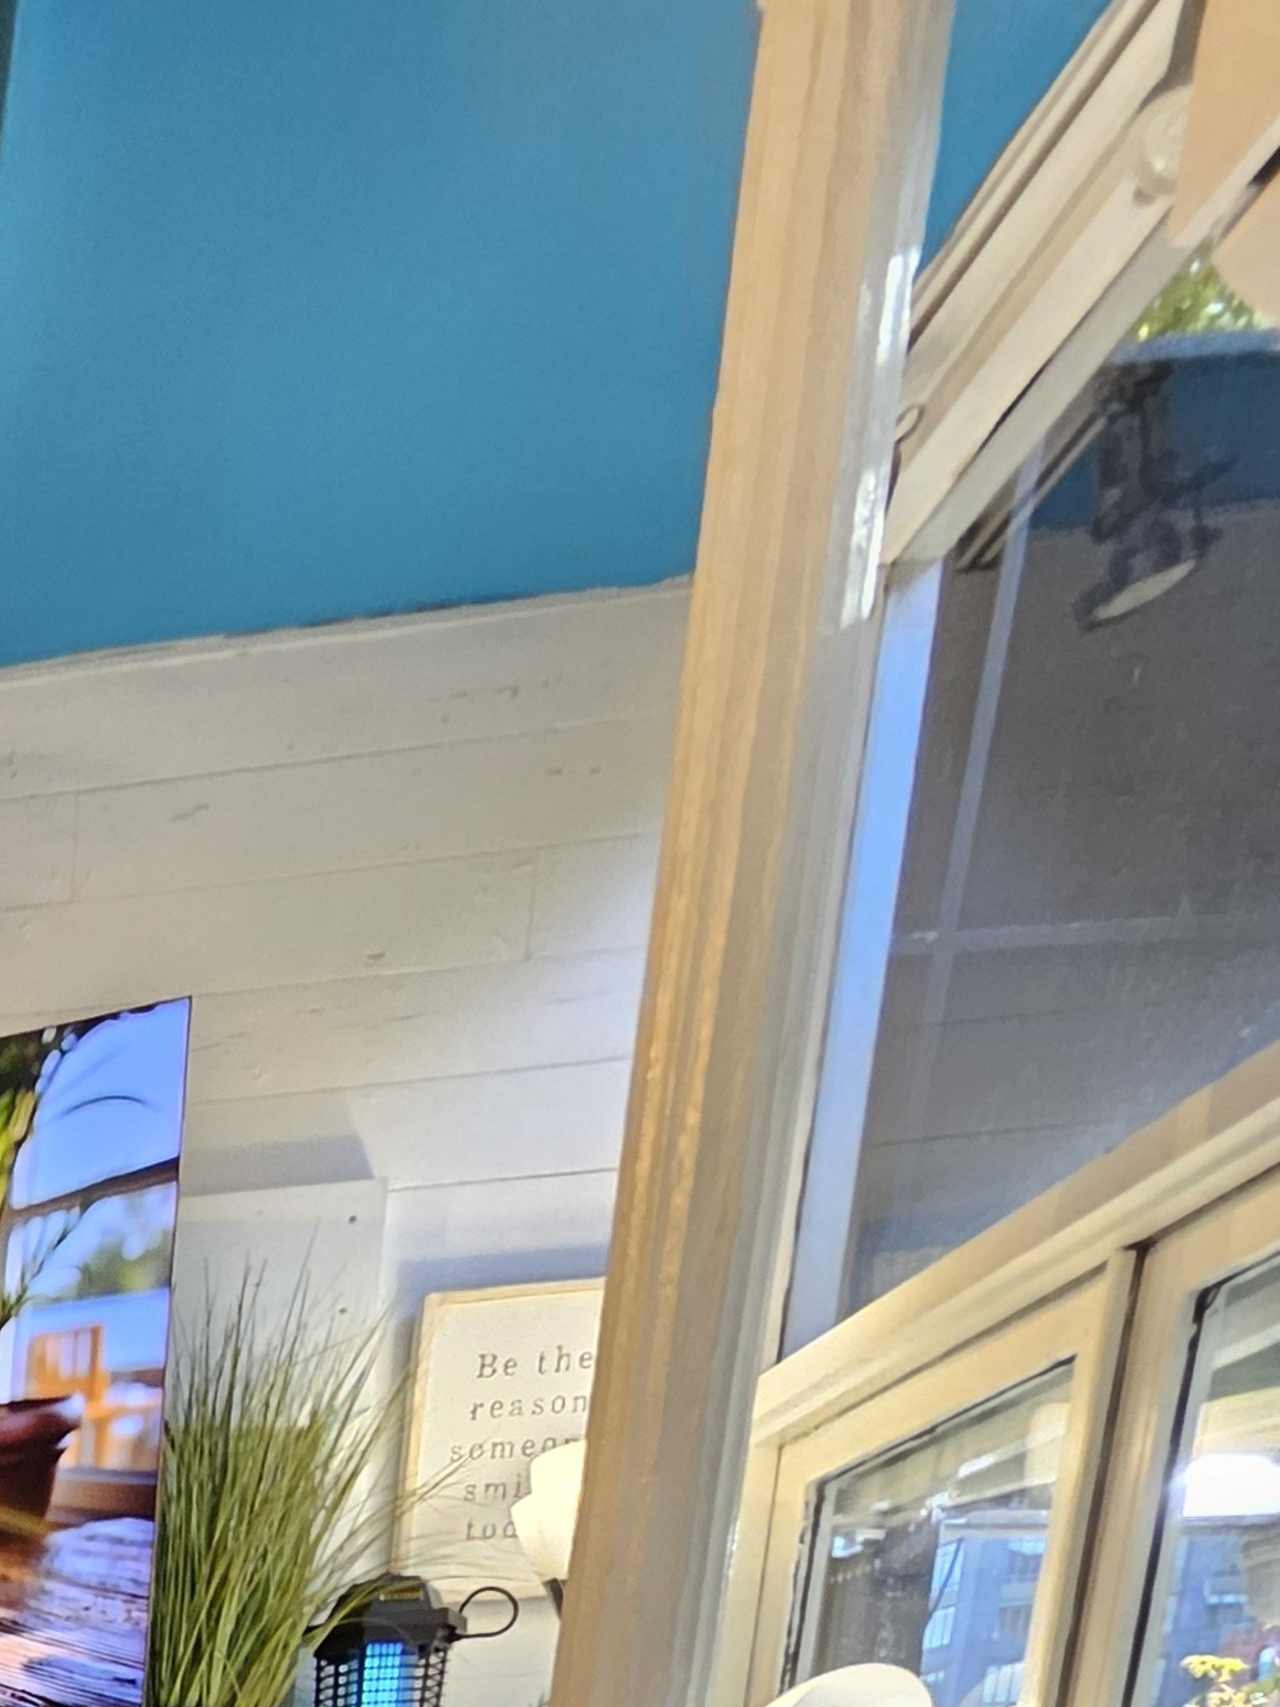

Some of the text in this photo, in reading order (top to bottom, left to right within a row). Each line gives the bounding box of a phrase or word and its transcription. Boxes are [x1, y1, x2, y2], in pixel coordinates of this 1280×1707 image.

[476, 1344, 593, 1379] Be the
[469, 1394, 587, 1421] reason
